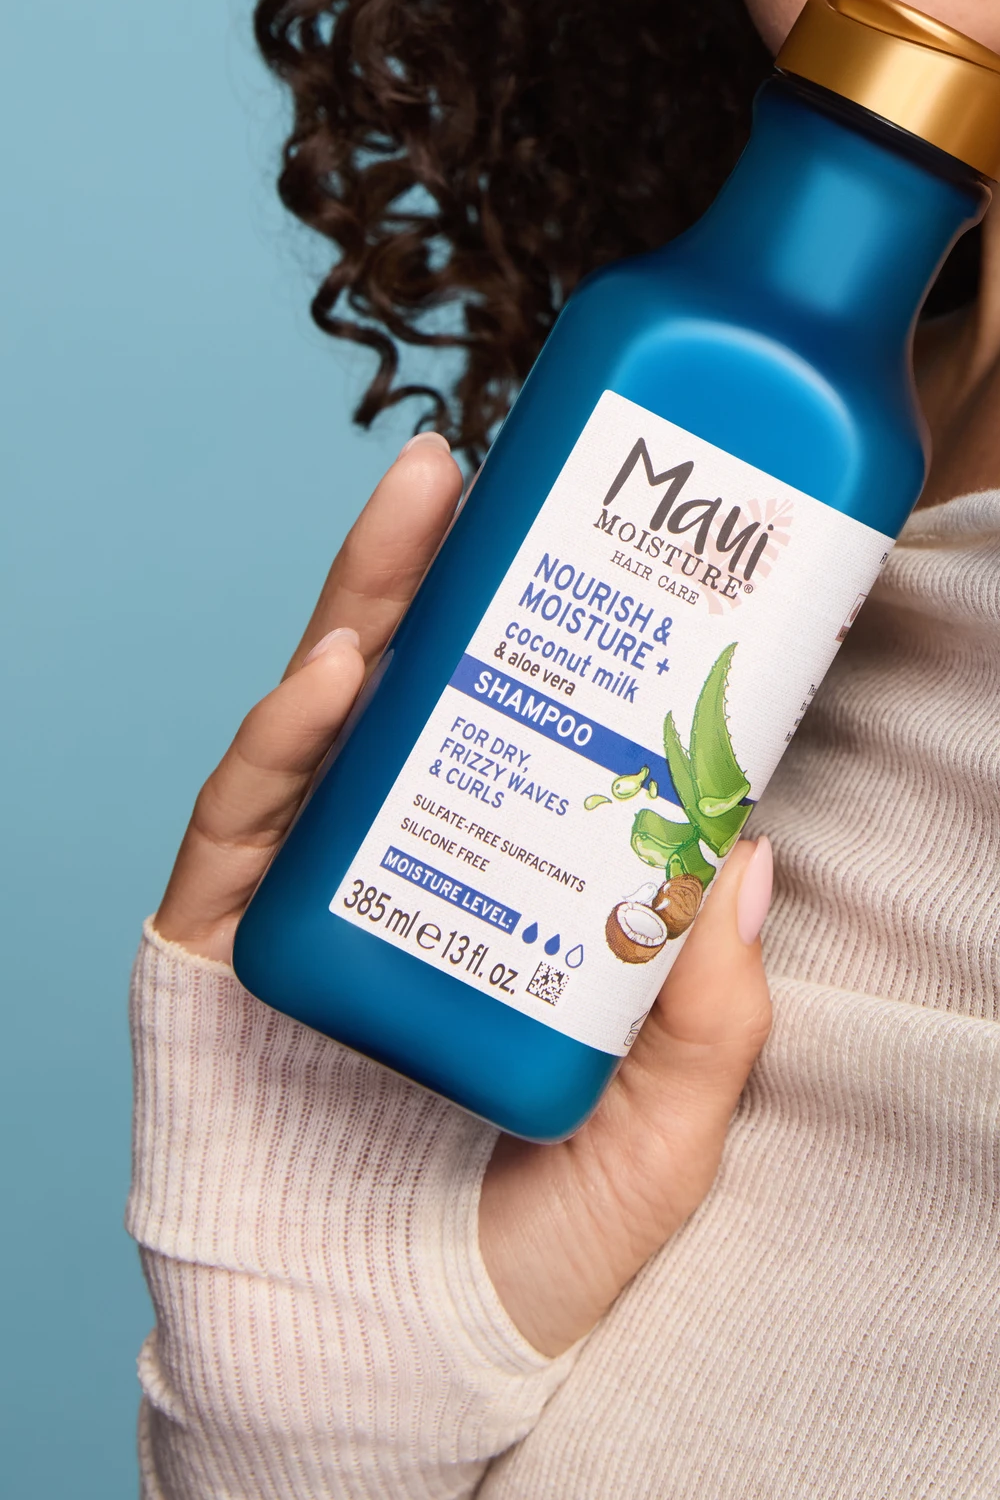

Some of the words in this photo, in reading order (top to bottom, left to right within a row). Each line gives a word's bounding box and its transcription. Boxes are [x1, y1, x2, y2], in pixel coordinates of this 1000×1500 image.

[603, 437, 774, 581] Maui
[533, 552, 654, 633] NOURISH
[653, 617, 673, 646] &
[610, 550, 653, 581] HAIR
[658, 575, 700, 605] CARE
[494, 641, 507, 660] &
[508, 651, 540, 677] aloe
[543, 669, 576, 696] vera
[505, 621, 592, 678] coconut
[591, 667, 640, 704] milk
[518, 582, 654, 671] MOISTURE
[656, 658, 671, 676] +
[450, 716, 490, 748] FOR
[489, 738, 532, 773] DRY,
[474, 671, 593, 747] SHAMPOO
[429, 759, 442, 778] &
[446, 768, 505, 809] CURLS
[440, 737, 507, 782] FRIZZY
[507, 772, 570, 816] WAVES
[400, 817, 456, 855] SILICONE
[456, 846, 491, 872] FREE
[413, 794, 501, 848] SULFATE-FREE
[500, 840, 586, 893] SURFACTANTS
[384, 850, 463, 901] MOISTURE
[462, 891, 513, 929] LEVEL:
[343, 879, 392, 922] 385
[385, 907, 421, 939] ml
[441, 930, 471, 964] 13
[465, 943, 490, 978] fl.
[488, 963, 519, 995] oz.
